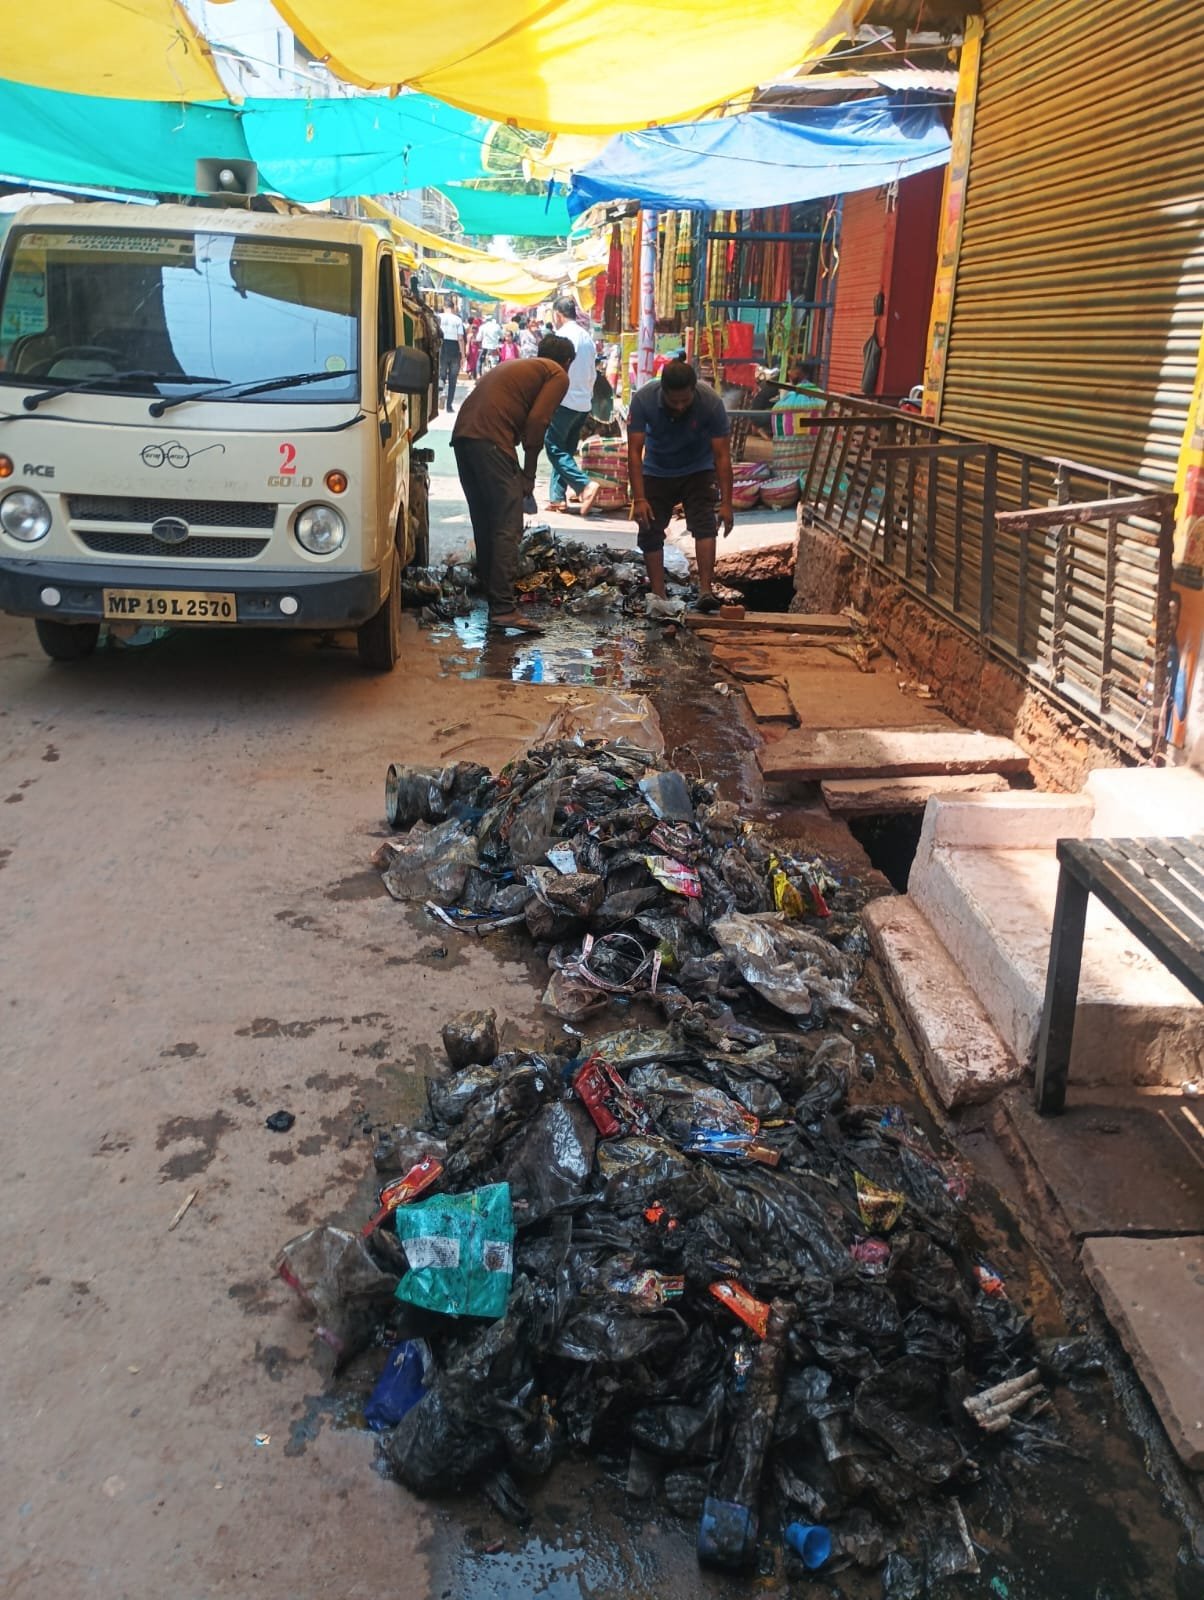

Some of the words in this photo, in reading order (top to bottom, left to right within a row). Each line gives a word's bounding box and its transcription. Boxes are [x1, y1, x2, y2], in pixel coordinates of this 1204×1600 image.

[279, 443, 297, 475] 2
[23, 463, 56, 478] ACE
[267, 475, 314, 488] GOD
[108, 596, 142, 614] MP
[146, 598, 168, 615] 19
[171, 599, 184, 616] L
[186, 599, 232, 618] 2570
